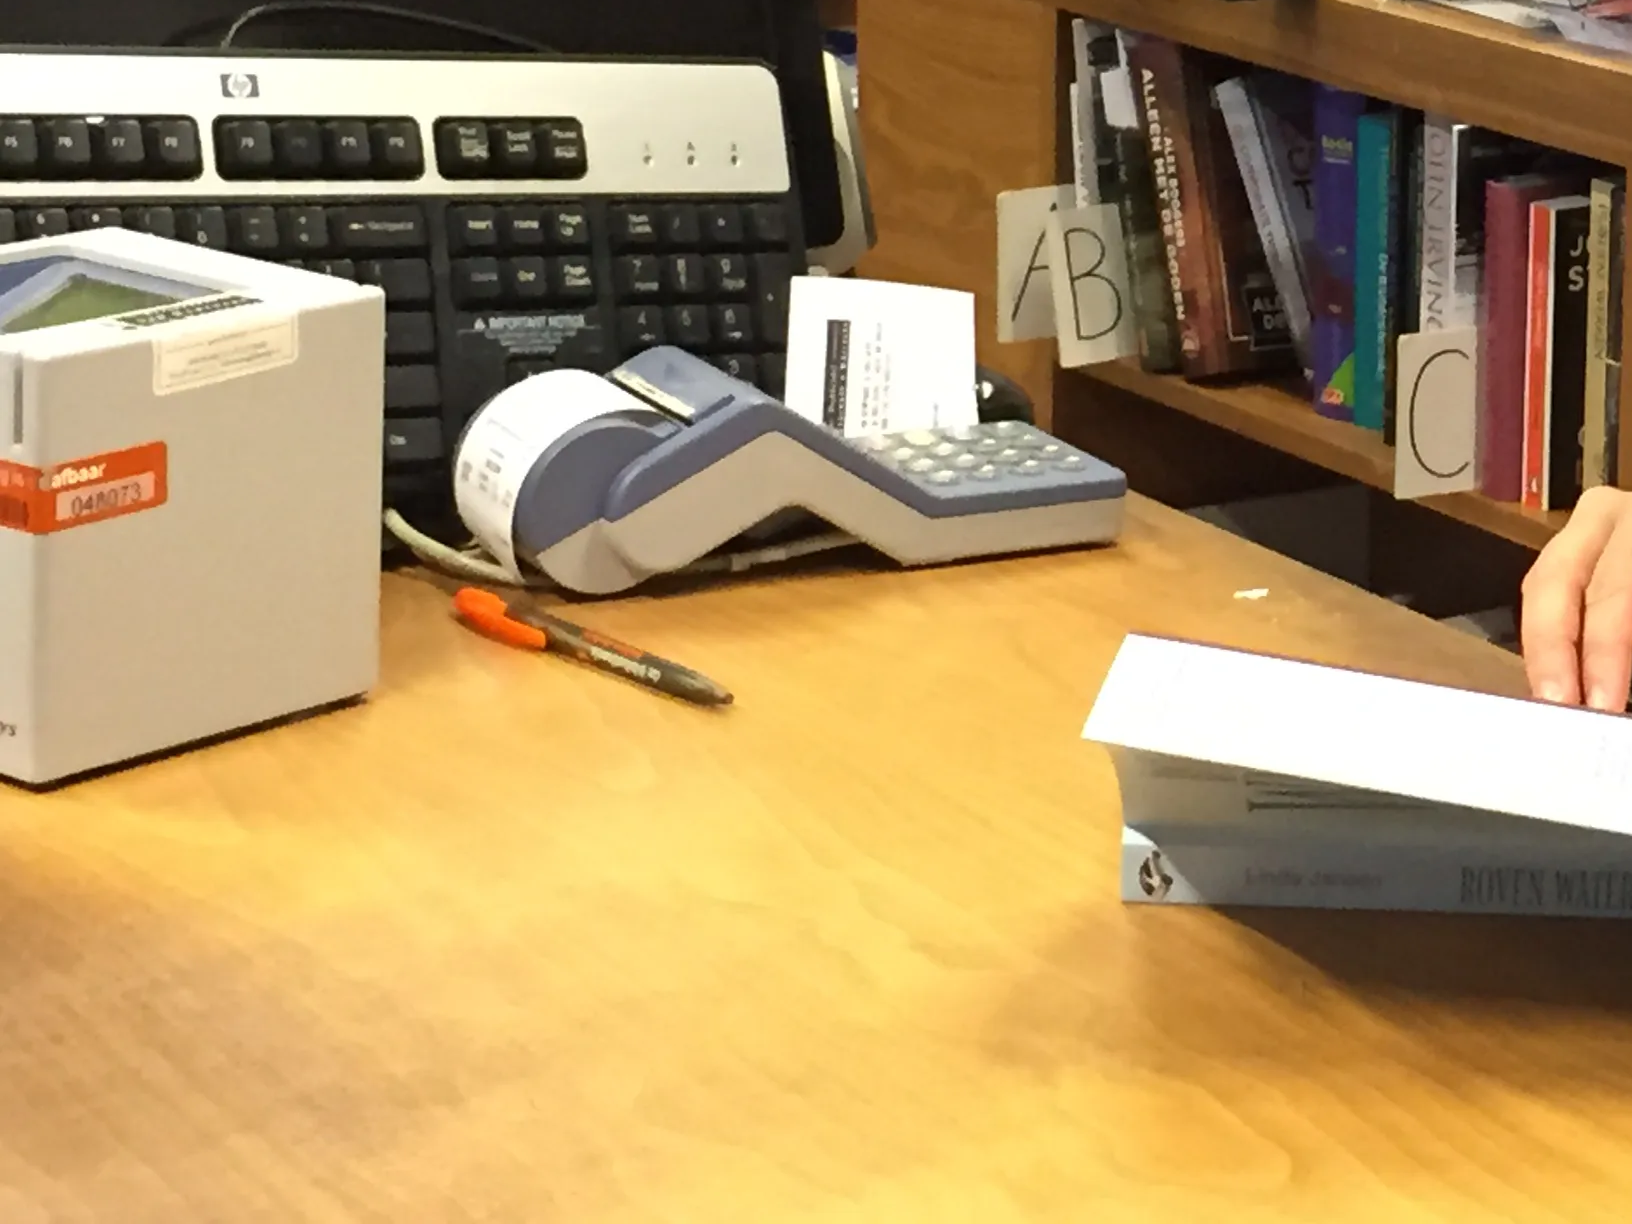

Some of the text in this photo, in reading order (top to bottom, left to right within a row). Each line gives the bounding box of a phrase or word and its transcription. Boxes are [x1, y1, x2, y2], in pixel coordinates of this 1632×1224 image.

[1141, 68, 1186, 321] ALLEEN MET DE GODEN
[1427, 132, 1449, 210] OHN
[1011, 202, 1058, 322] A
[1063, 226, 1123, 341] B
[1409, 347, 1470, 479] C
[1458, 864, 1545, 908] BOVEN
